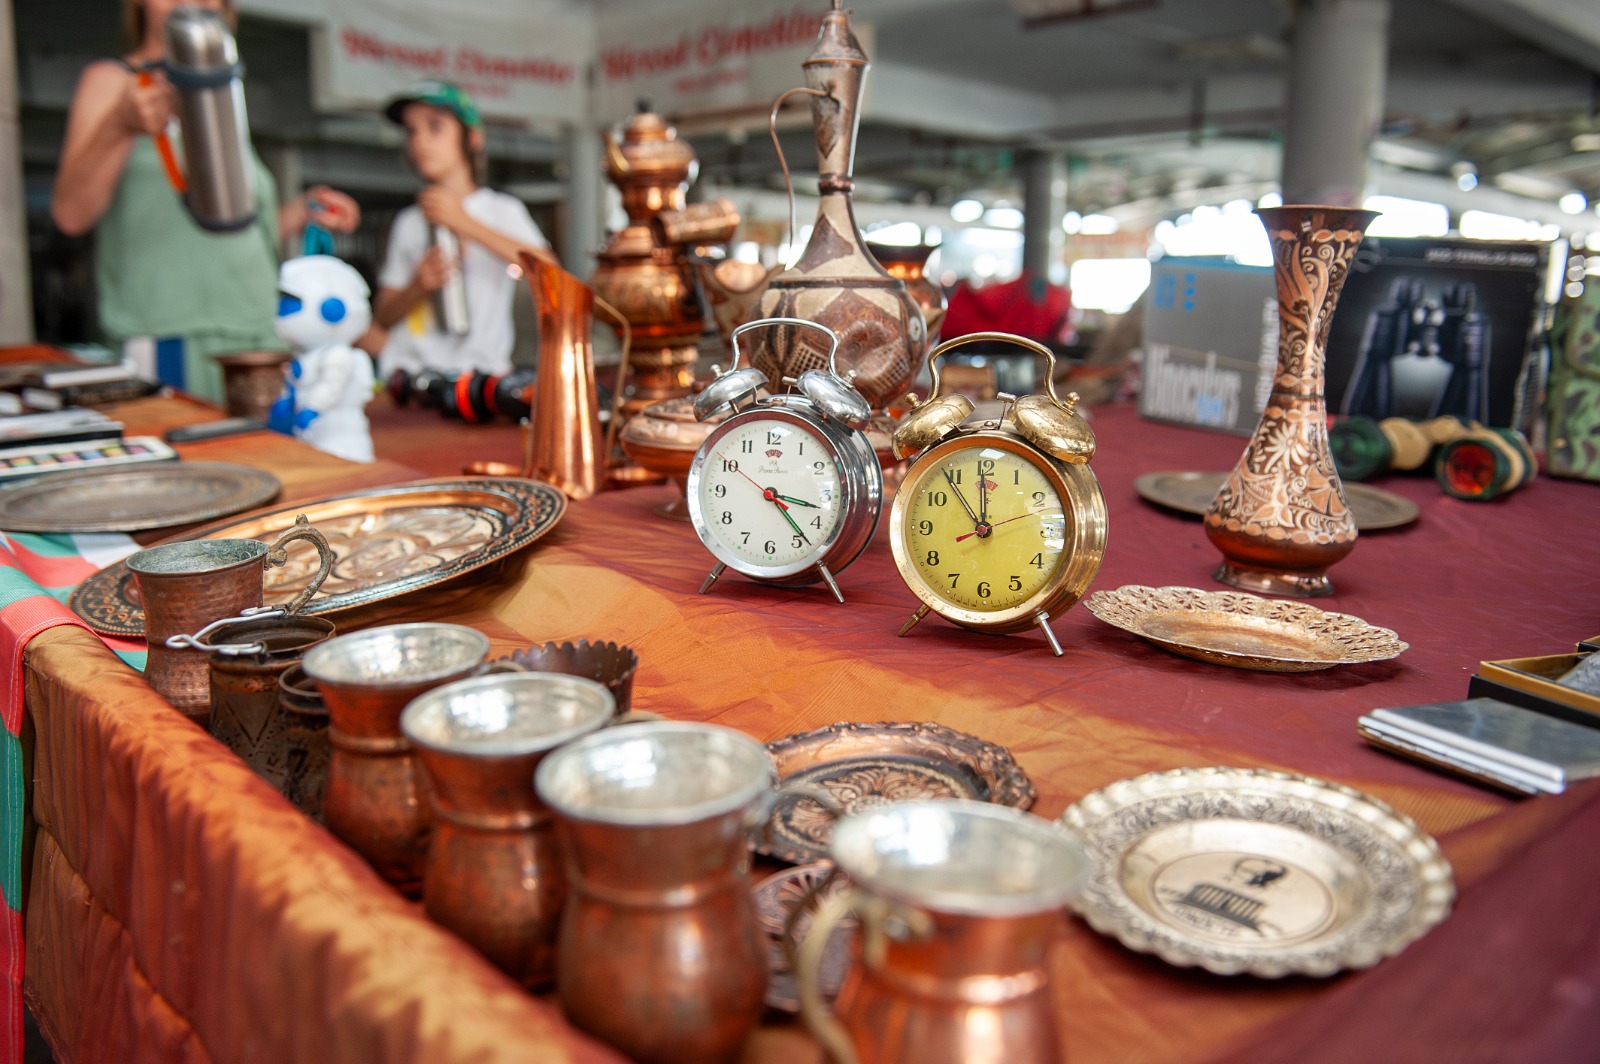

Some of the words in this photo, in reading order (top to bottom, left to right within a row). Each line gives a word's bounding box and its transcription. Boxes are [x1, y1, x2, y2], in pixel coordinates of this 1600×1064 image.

[766, 431, 782, 445] 12
[741, 440, 753, 454] 11
[798, 442, 803, 456] 1
[722, 459, 739, 472] 10
[813, 461, 825, 475] 2
[976, 460, 995, 476] 12
[949, 469, 962, 484] 11
[1013, 469, 1019, 485] 1
[715, 484, 727, 498] 9
[820, 489, 831, 503] 3
[927, 491, 947, 507] 10
[1032, 491, 1046, 507] 2
[721, 511, 733, 524] 8
[810, 515, 823, 529] 4
[919, 520, 933, 535] 9
[740, 531, 751, 544] 7
[791, 535, 803, 548] 5
[764, 540, 776, 554] 6
[926, 551, 940, 566] 8
[1029, 553, 1044, 569] 4
[948, 574, 960, 588] 7
[1008, 576, 1022, 591] 5
[977, 582, 991, 598] 6
